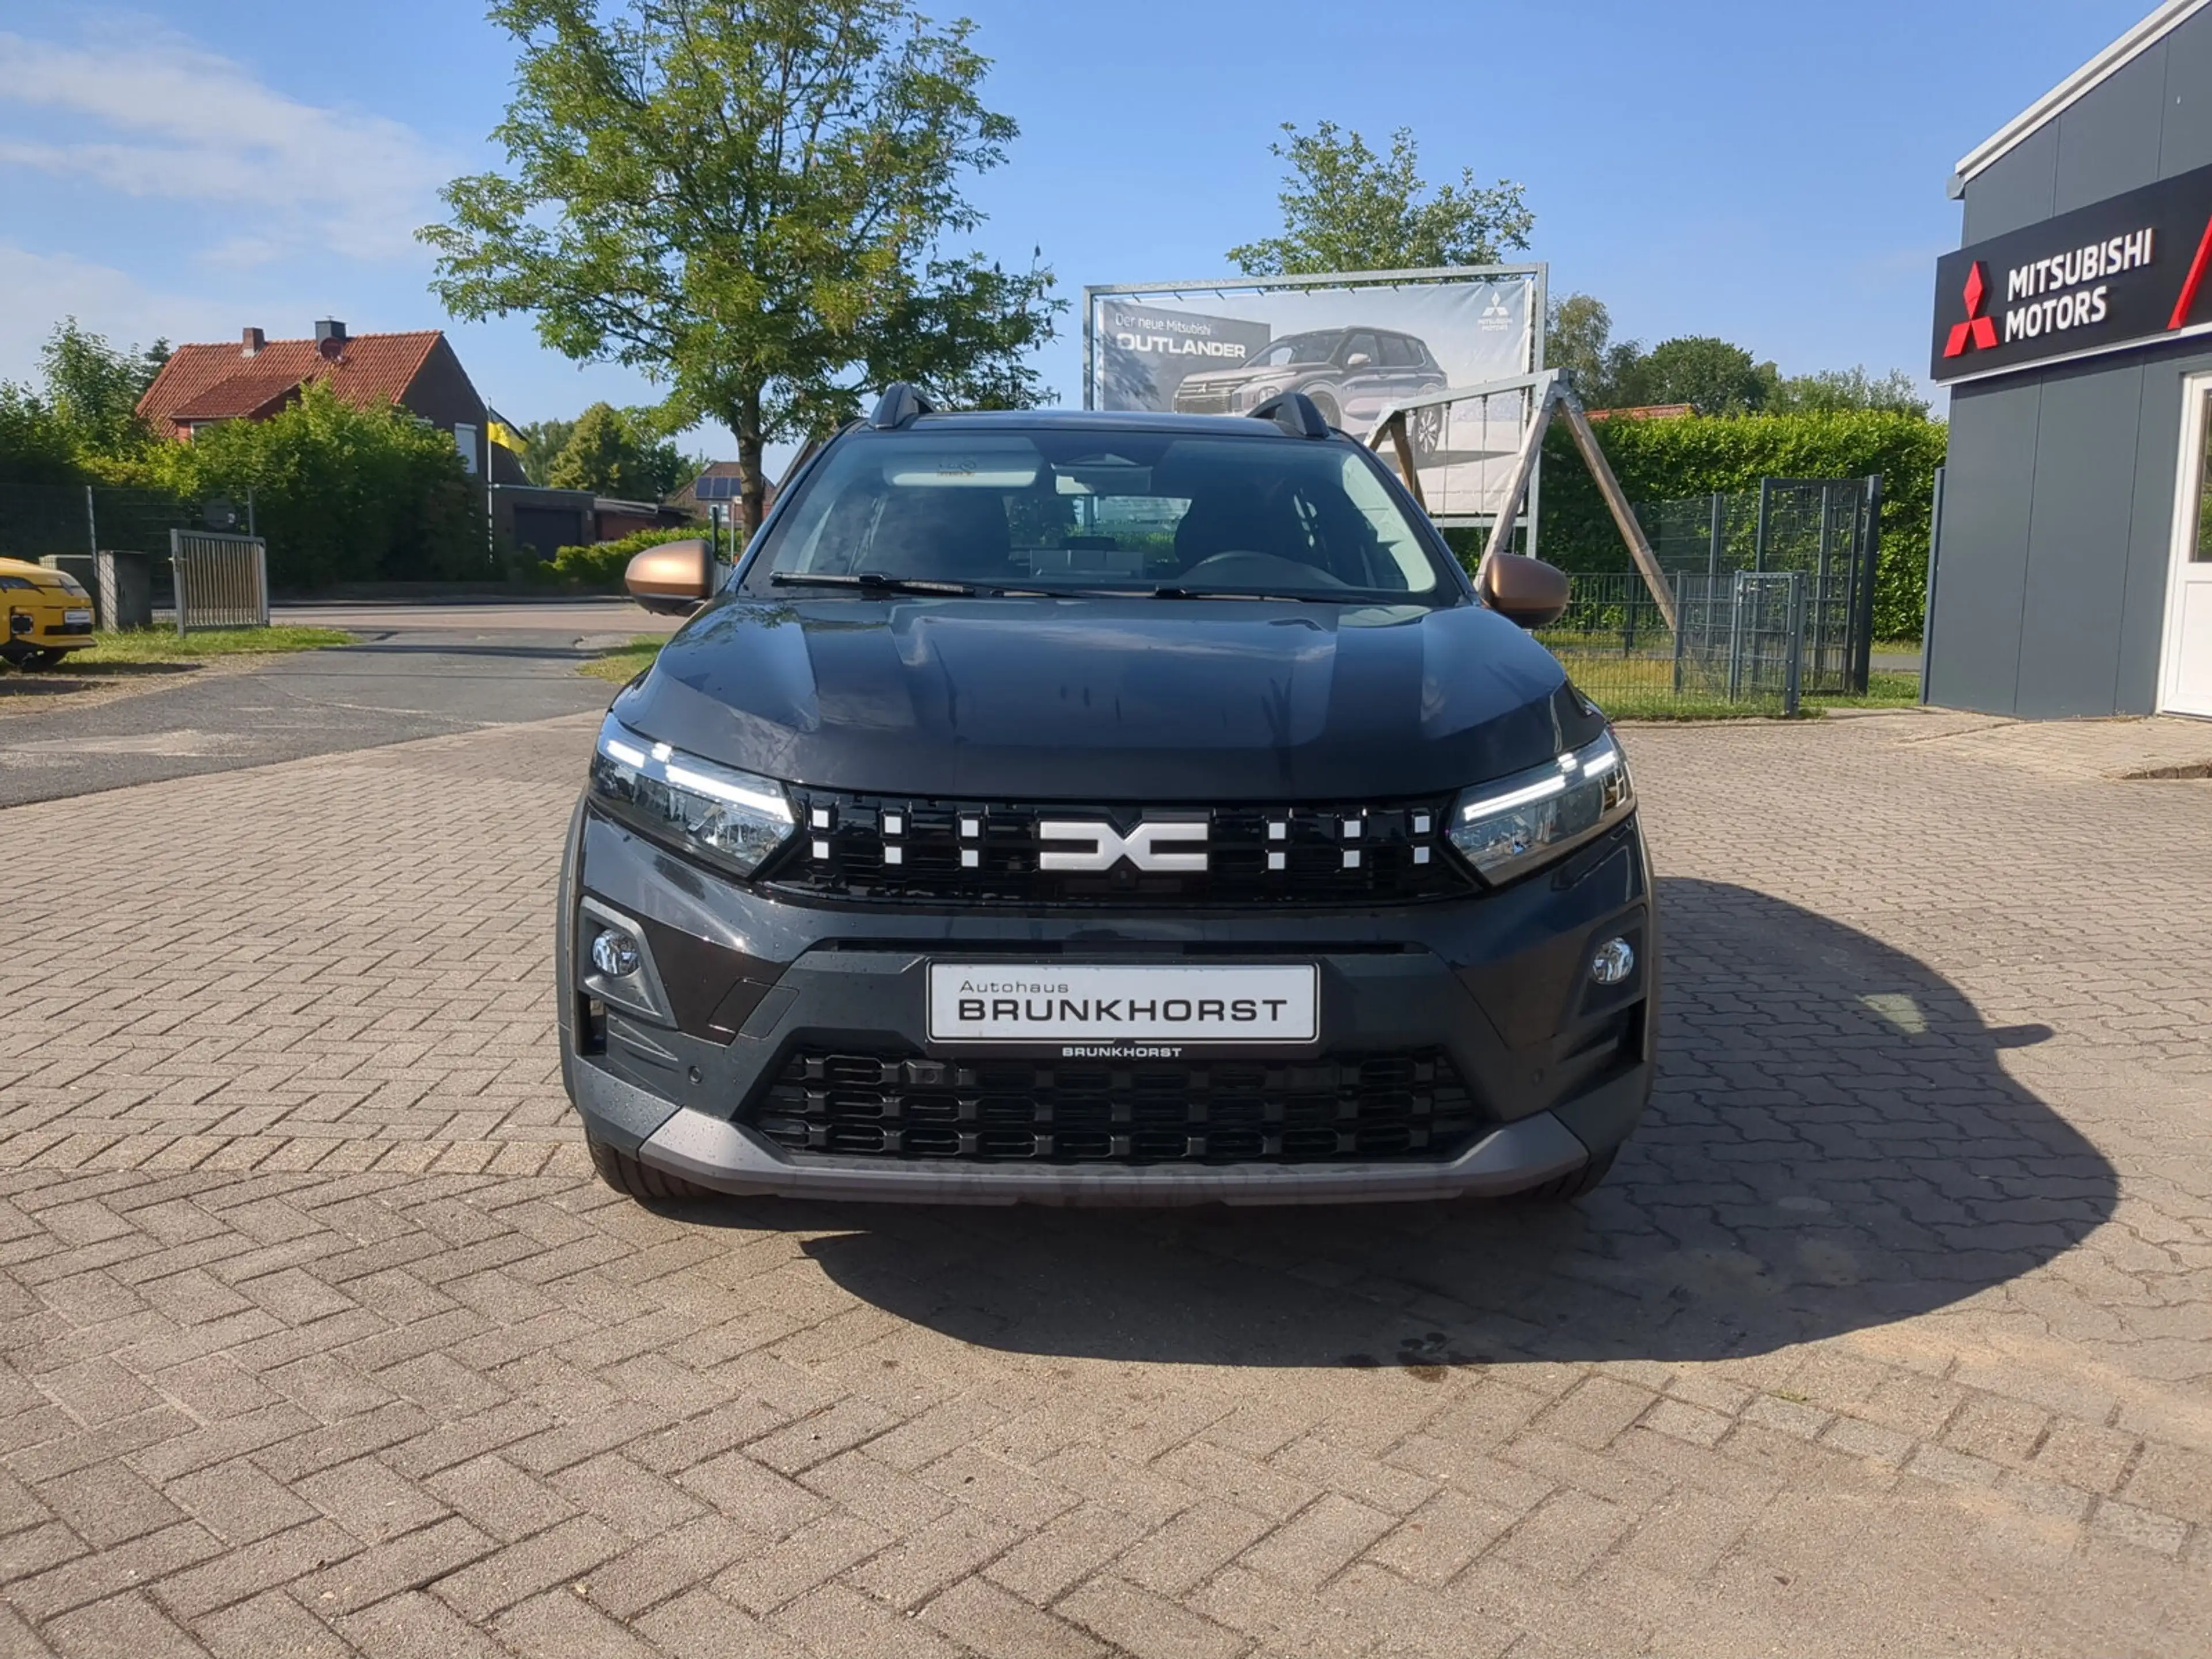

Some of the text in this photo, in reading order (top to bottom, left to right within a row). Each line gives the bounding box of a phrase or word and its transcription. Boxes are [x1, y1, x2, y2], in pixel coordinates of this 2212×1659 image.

[2008, 228, 2153, 302] MITSUBISHI
[1115, 313, 1211, 336] Der neue Mitsubishi
[2005, 286, 2107, 343] MOTORS
[1116, 333, 1246, 358] OUTLANDER
[960, 980, 1069, 993] Autohaus
[959, 999, 1287, 1021] BRUNKHORST
[1062, 1047, 1182, 1057] BRUNKHORST
